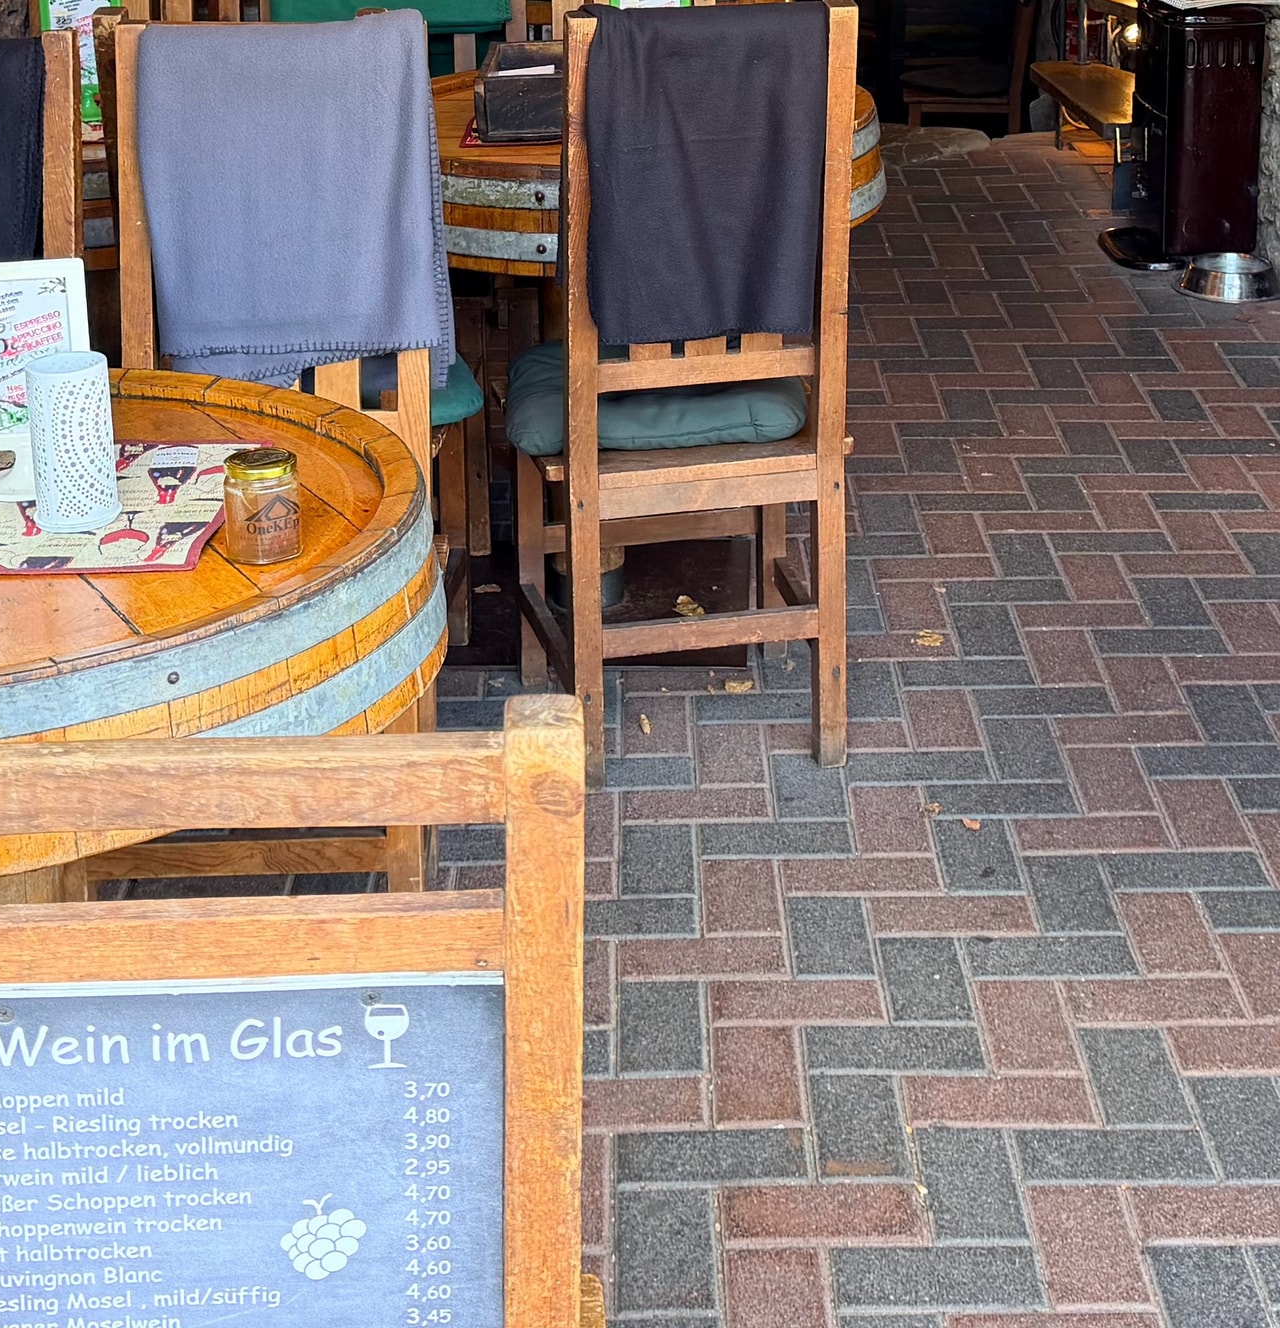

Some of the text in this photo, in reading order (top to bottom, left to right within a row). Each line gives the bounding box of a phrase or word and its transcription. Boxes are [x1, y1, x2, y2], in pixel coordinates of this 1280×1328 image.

[14, 309, 61, 332] ESPRESSO
[151, 1022, 210, 1064] im
[230, 1017, 343, 1061] Glas
[76, 1086, 125, 1107] mild
[404, 1080, 450, 1101] 3,70
[52, 1113, 141, 1137] Riesling
[148, 1110, 238, 1130] trocken
[404, 1107, 450, 1128] 4,80
[23, 1137, 172, 1161] halbtrocken,
[176, 1134, 293, 1159] vollmundig
[404, 1132, 450, 1153] 3,90
[61, 1165, 109, 1186] mild
[136, 1162, 218, 1183] lieblich
[404, 1158, 450, 1178] 2,95
[47, 1191, 158, 1217] Schoppen
[164, 1187, 252, 1207] trocken
[404, 1183, 450, 1205] 4,70
[135, 1213, 223, 1235] trocken
[404, 1208, 451, 1229] 4,70
[16, 1241, 153, 1263] halbtrocken
[404, 1233, 451, 1254] 3,60
[104, 1265, 164, 1285] Blanc
[404, 1258, 451, 1279] 4,60
[66, 1291, 132, 1311] Mosel
[154, 1285, 282, 1311] mild/süffig
[405, 1282, 451, 1303] 4,60
[405, 1307, 452, 1328] 3,45
